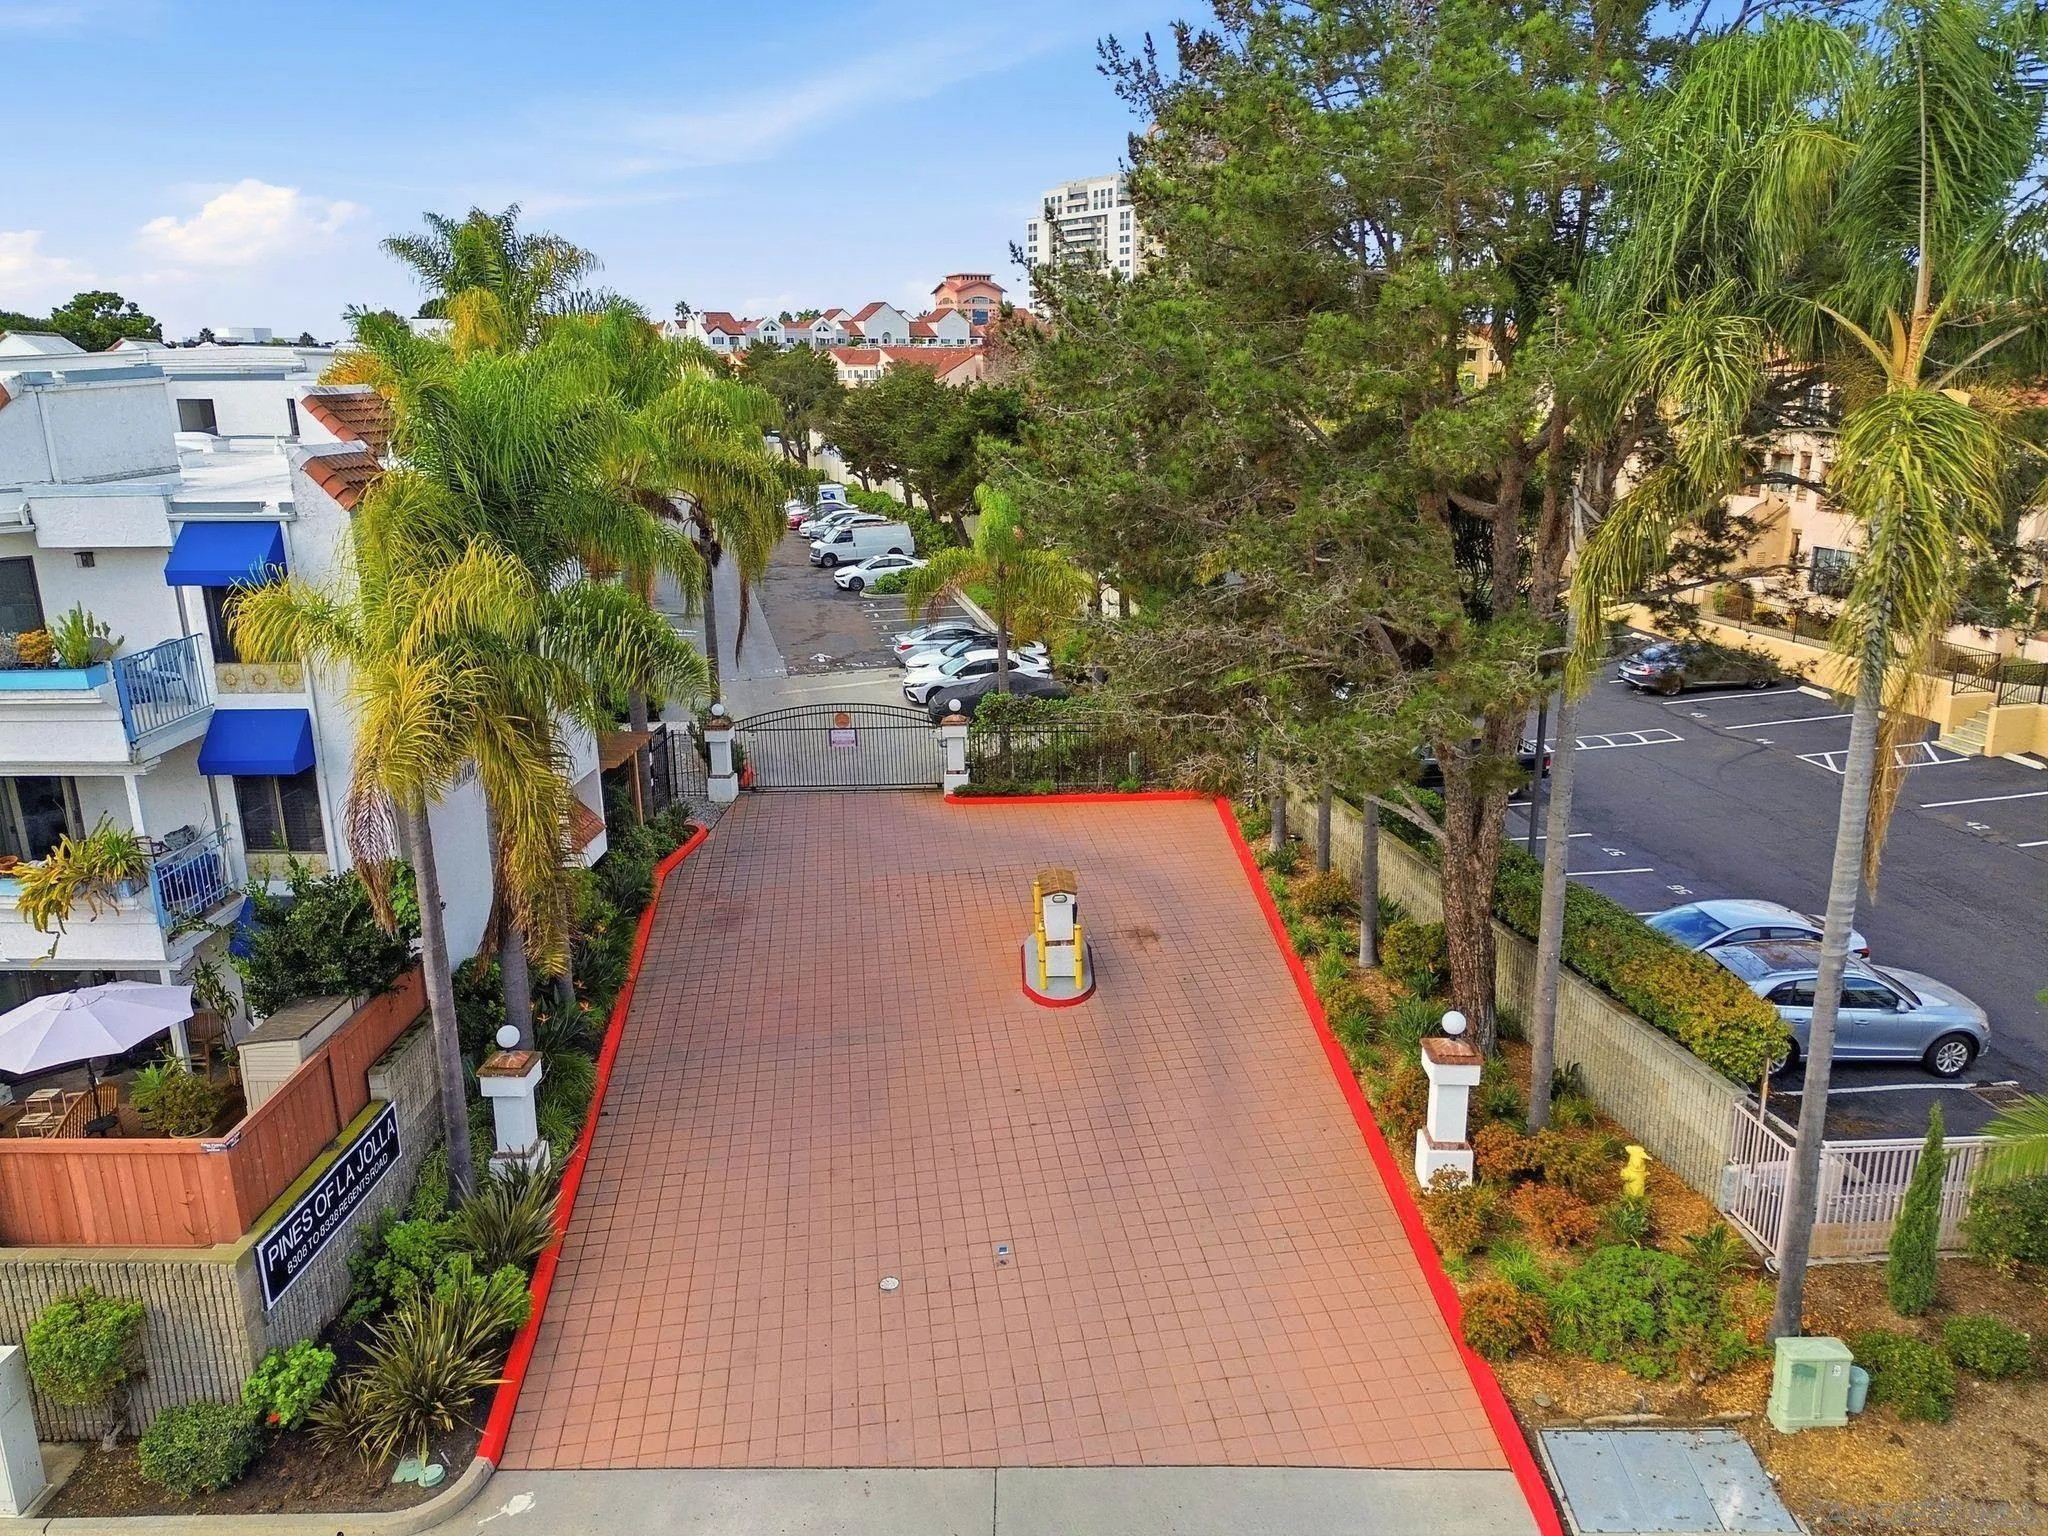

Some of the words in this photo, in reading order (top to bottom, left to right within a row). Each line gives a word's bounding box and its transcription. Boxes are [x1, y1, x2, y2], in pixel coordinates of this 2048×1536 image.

[267, 1207, 314, 1272] PINES
[314, 1181, 335, 1218] OF
[335, 1163, 356, 1197] LA
[356, 1117, 396, 1173] JOLLA
[287, 1243, 308, 1275] 8308
[307, 1231, 320, 1250] TO
[320, 1208, 340, 1237] 8338
[339, 1172, 371, 1216] REGENTS
[369, 1152, 389, 1180] ROAD
